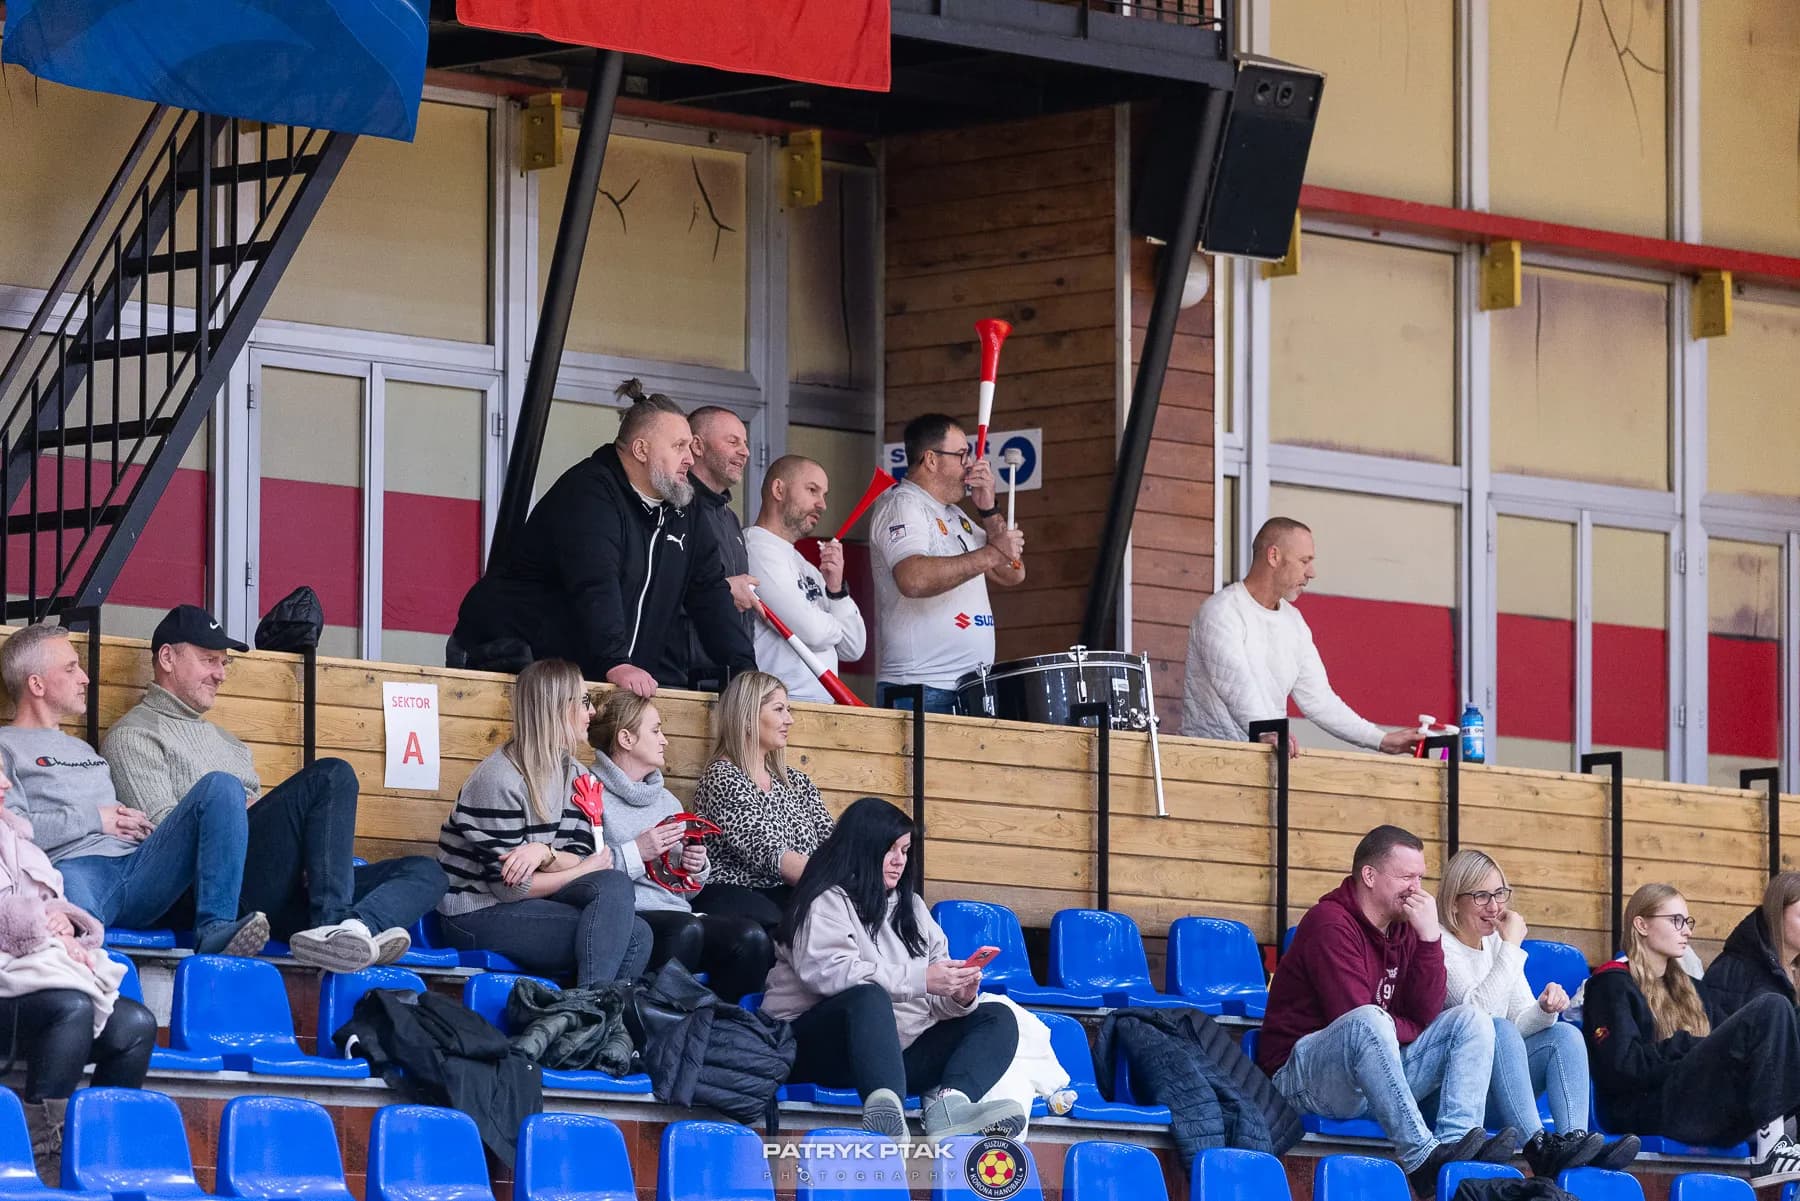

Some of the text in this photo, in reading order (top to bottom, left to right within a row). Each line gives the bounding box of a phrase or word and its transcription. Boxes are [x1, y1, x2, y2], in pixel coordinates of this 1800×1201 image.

[391, 695, 431, 710] SEKTOR
[402, 731, 424, 765] A
[35, 755, 108, 769] Champion
